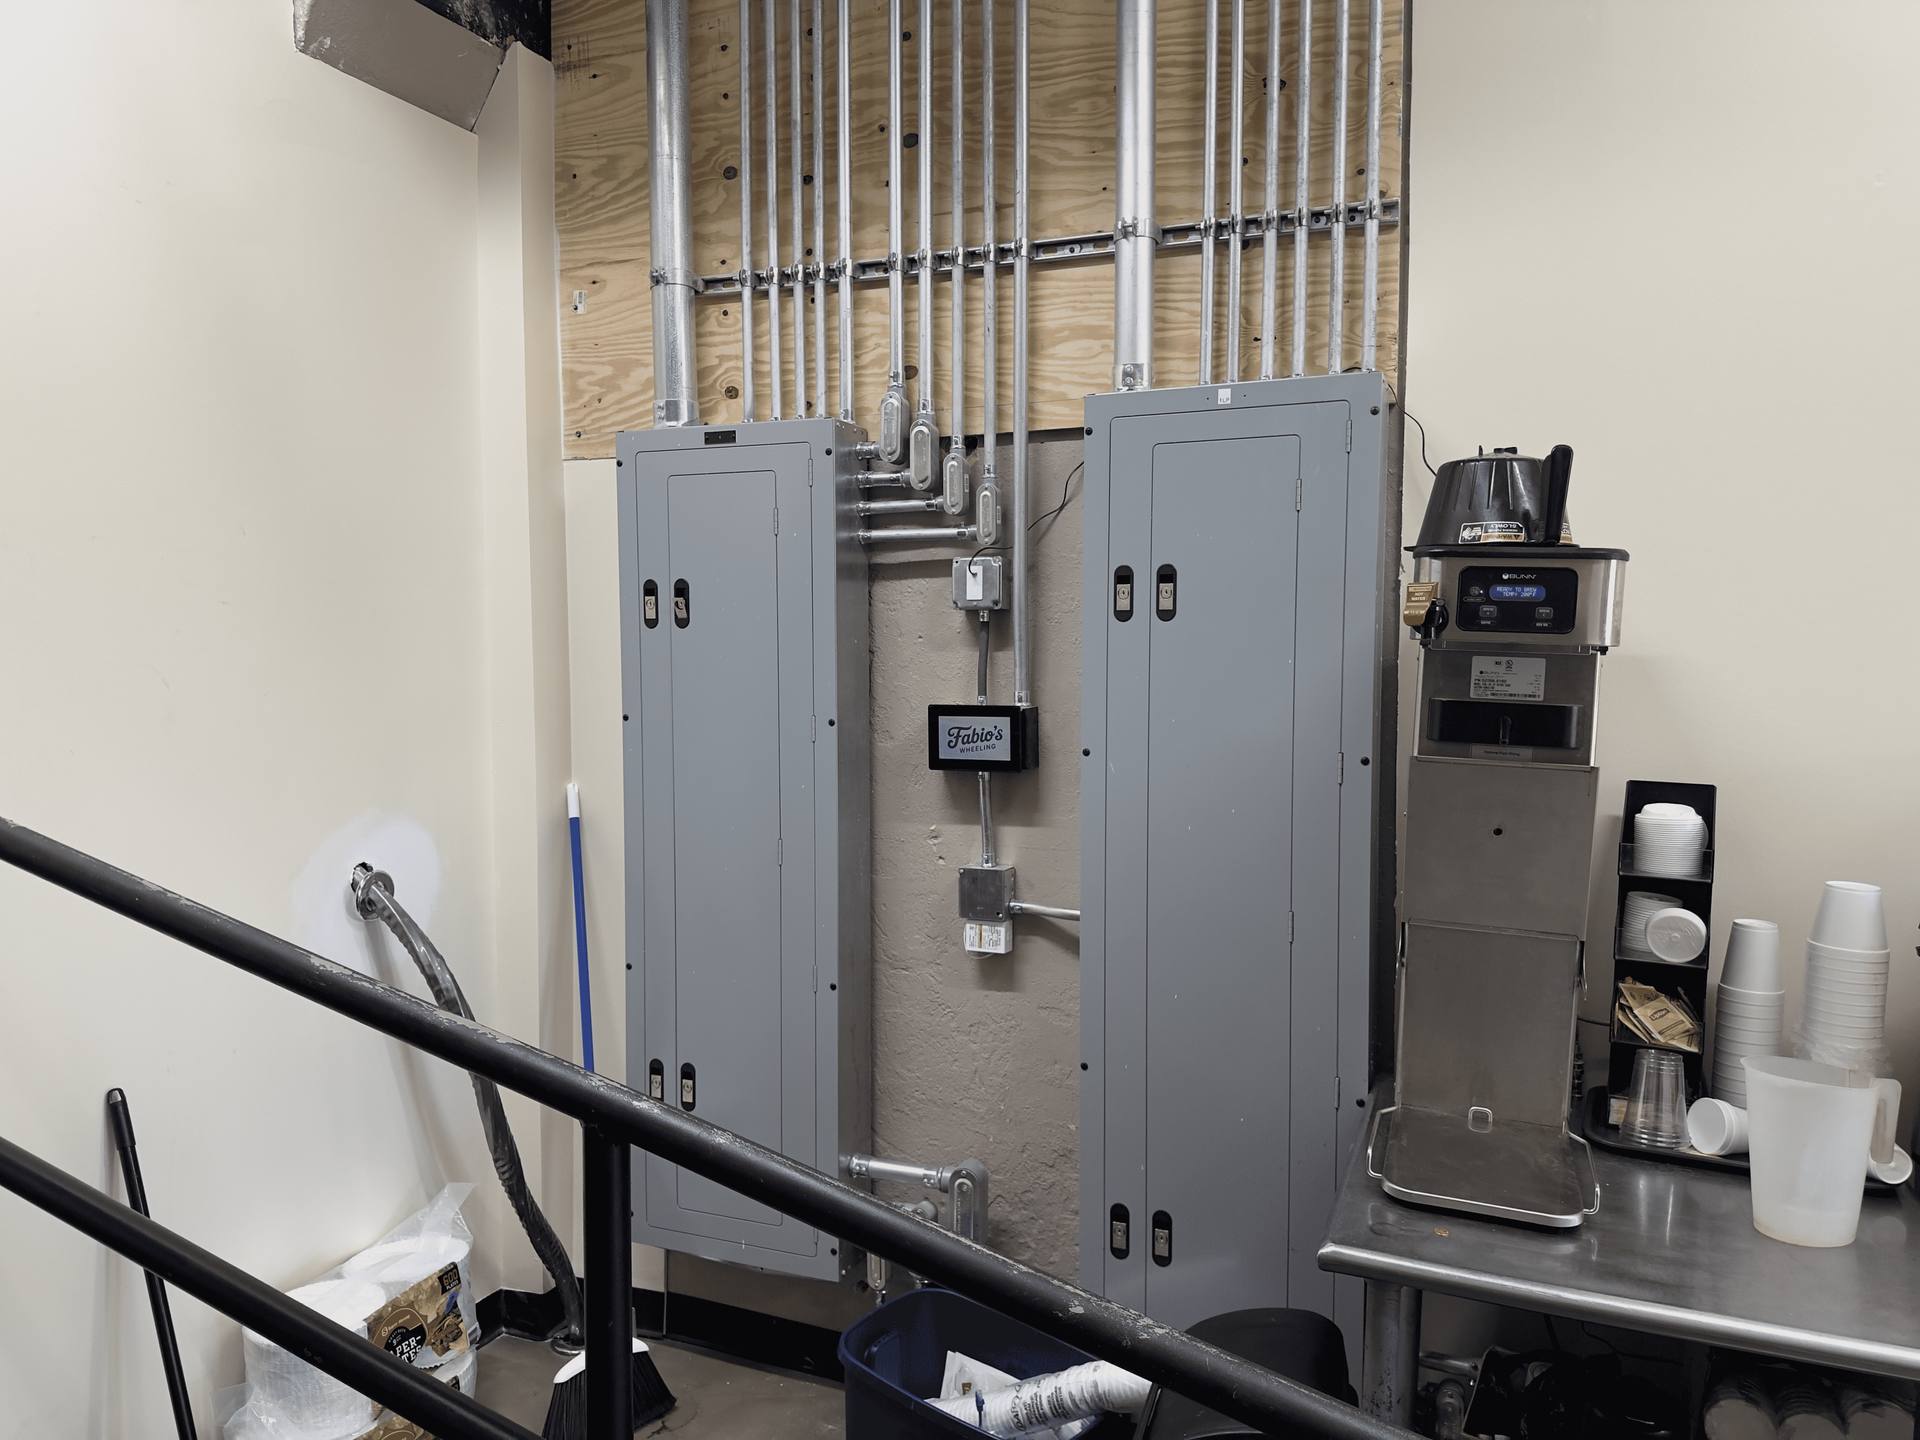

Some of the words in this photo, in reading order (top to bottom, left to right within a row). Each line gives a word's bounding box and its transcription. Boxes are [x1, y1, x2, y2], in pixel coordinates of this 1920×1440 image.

[948, 725, 1003, 749] Fabio's
[959, 744, 996, 753] WHEELING
[1651, 1010, 1666, 1019] Lipton
[442, 1268, 458, 1286] 600
[446, 1280, 459, 1290] PLATES
[390, 1336, 421, 1357] PER-
